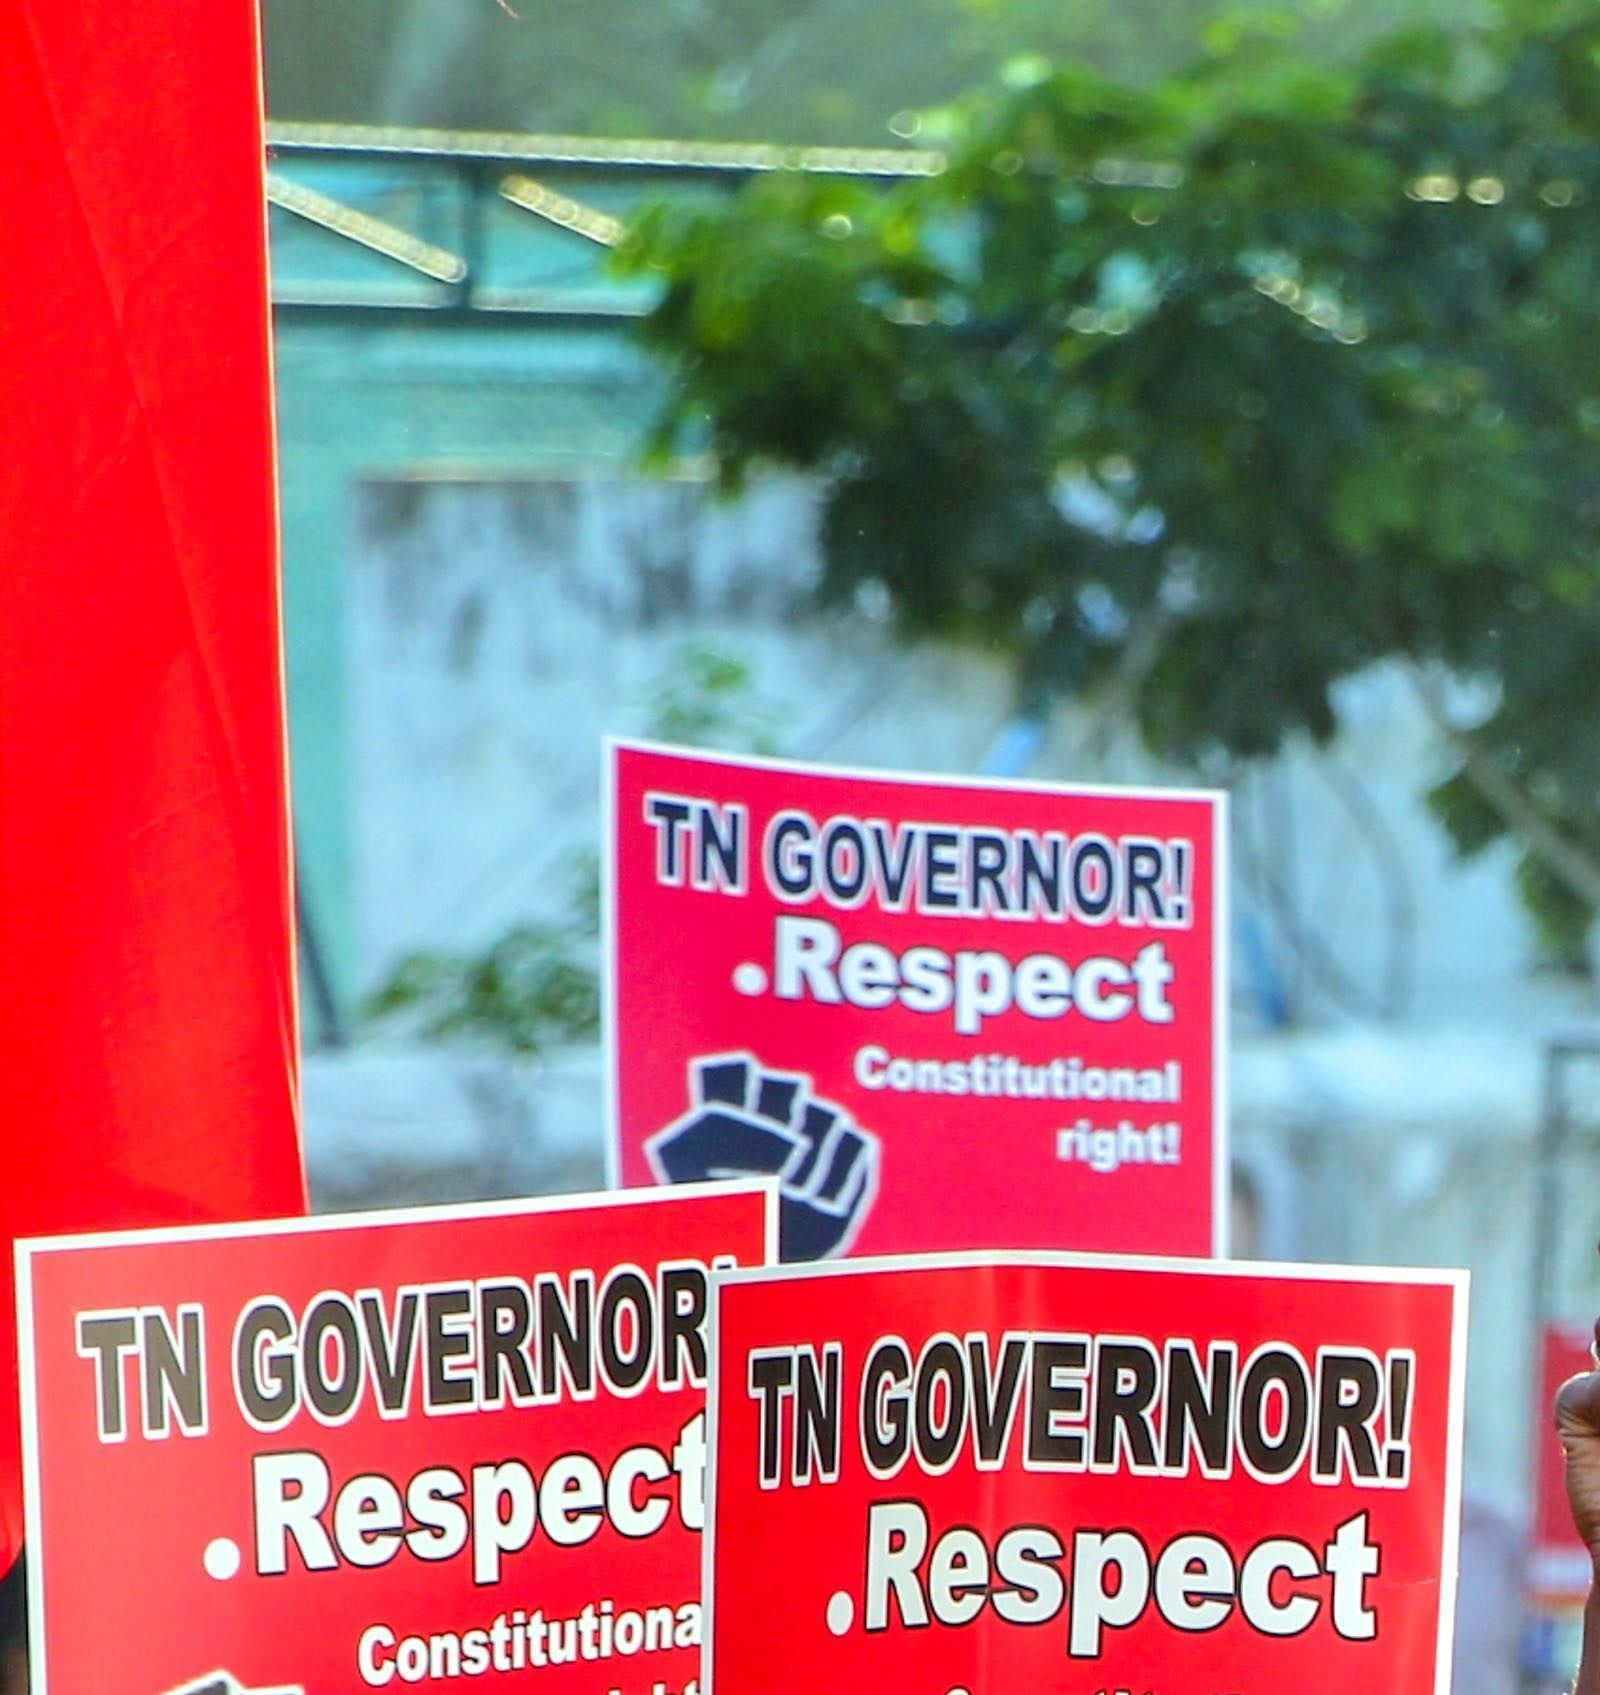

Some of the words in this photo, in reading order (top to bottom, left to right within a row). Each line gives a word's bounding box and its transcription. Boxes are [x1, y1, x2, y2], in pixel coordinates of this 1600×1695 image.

[644, 792, 747, 894] TN
[765, 808, 1193, 927] GOVERNOR!
[853, 1046, 1181, 1103] Constitutional
[1056, 1121, 1181, 1172] right!
[76, 1303, 207, 1443] TN
[232, 1256, 736, 1432] GOVERNOR
[749, 1341, 842, 1488] TN
[860, 1332, 1415, 1488] GOVERNOR!
[357, 1600, 702, 1686] Constitutiona
